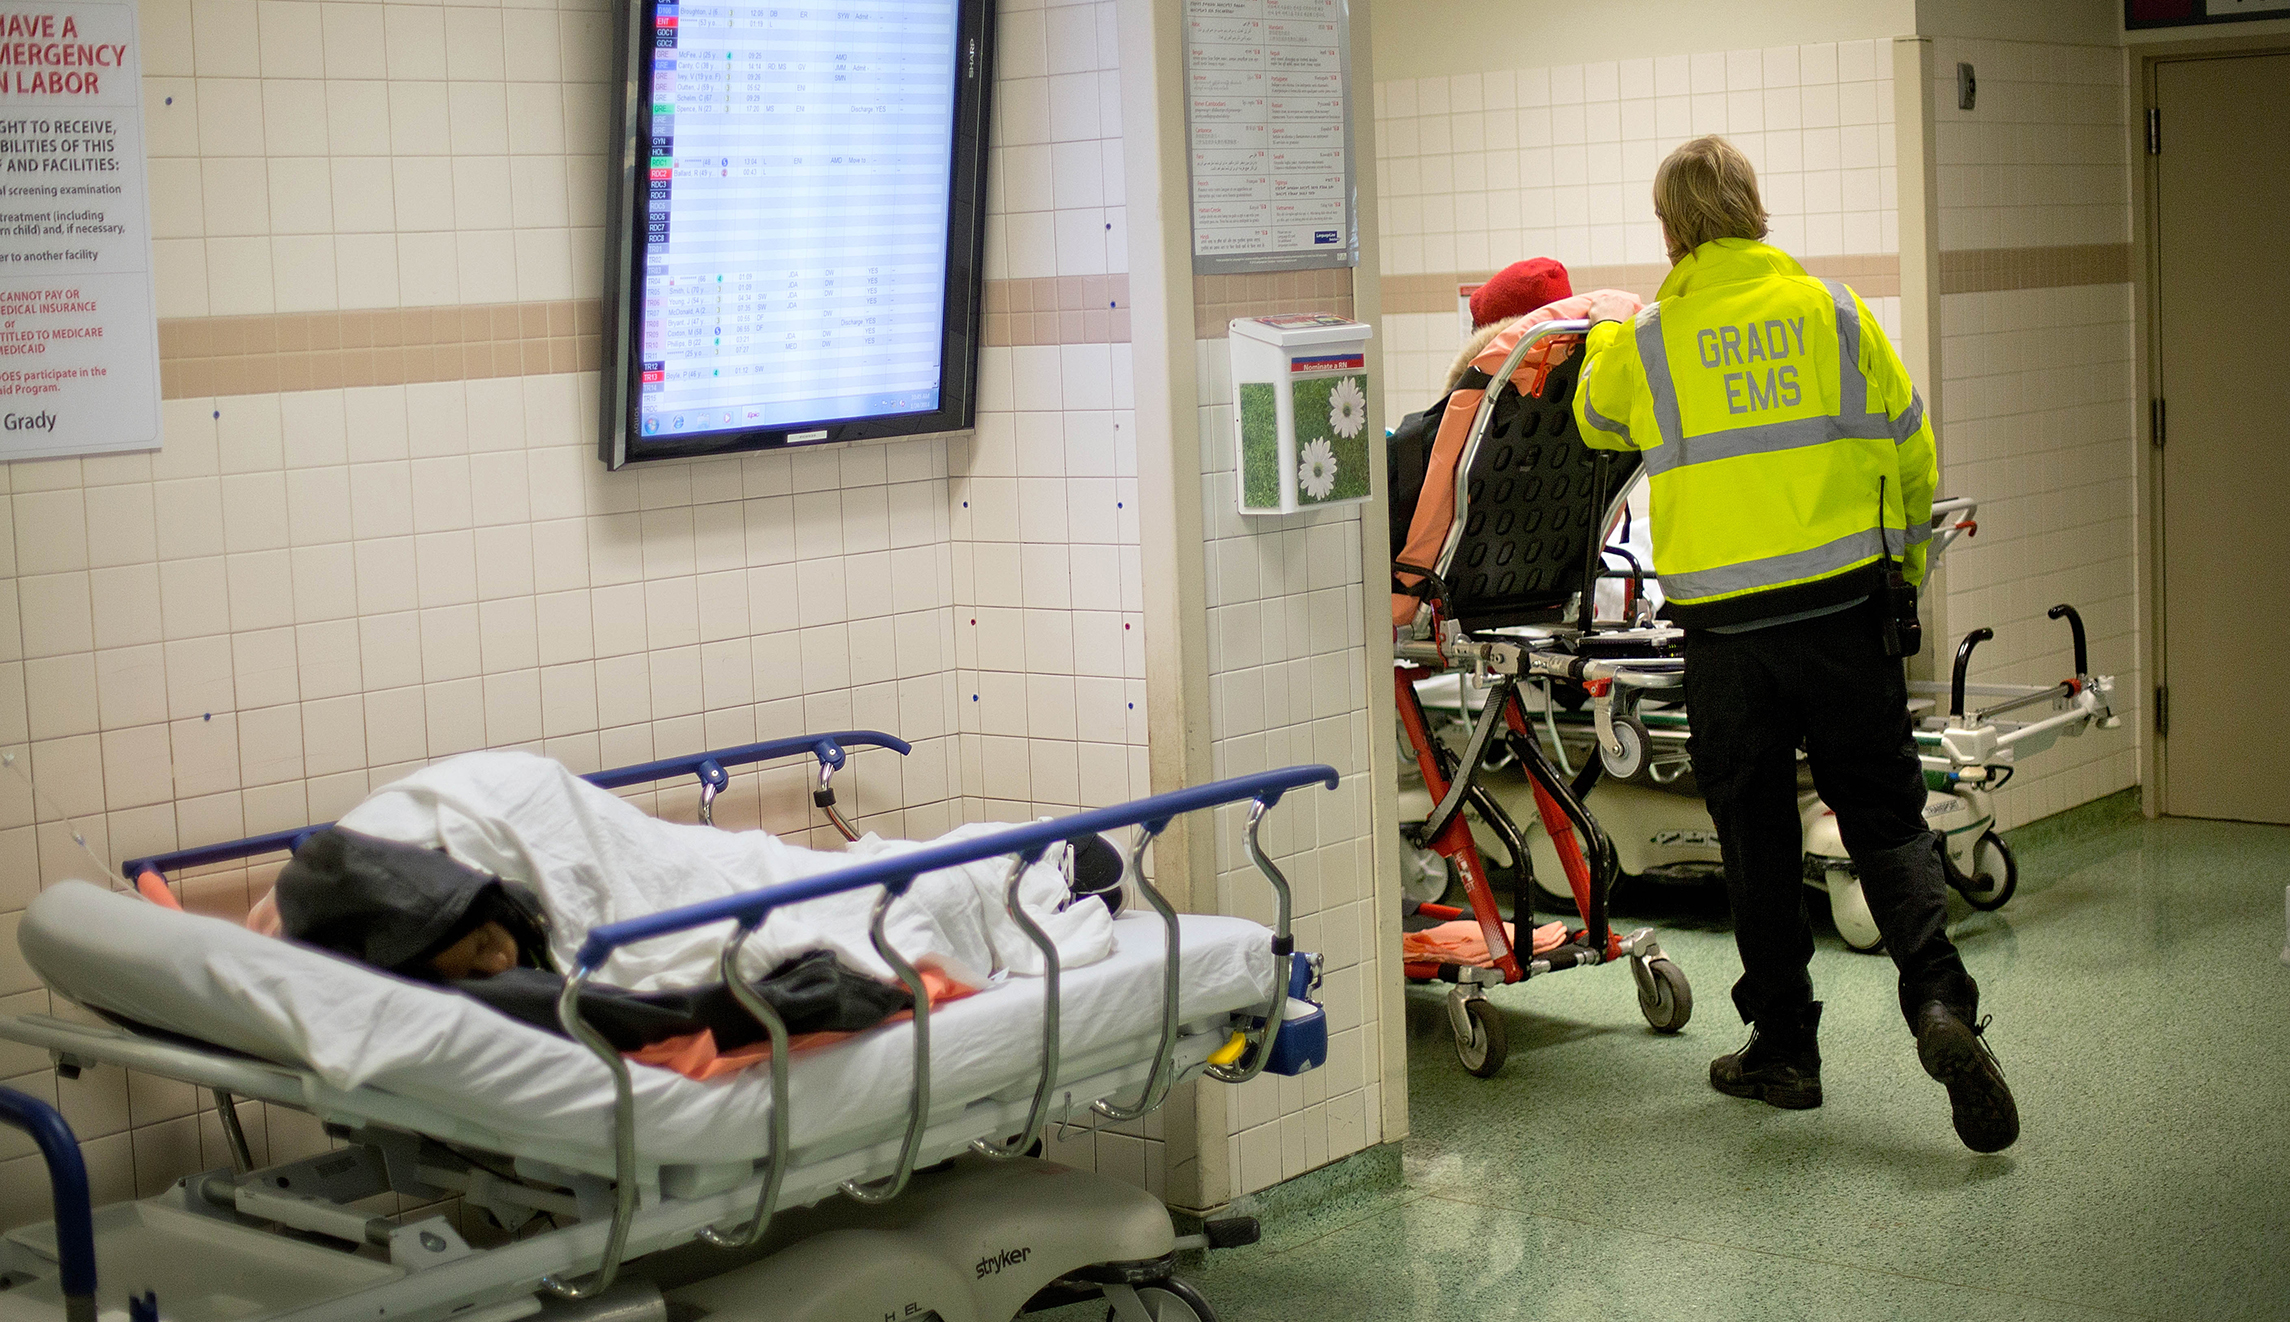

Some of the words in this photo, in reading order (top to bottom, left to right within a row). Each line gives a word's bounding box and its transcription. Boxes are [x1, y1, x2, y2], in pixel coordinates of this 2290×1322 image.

[0, 14, 54, 38] AVE
[62, 16, 78, 38] A
[17, 71, 99, 94] LABOR
[31, 121, 49, 133] TO
[54, 121, 117, 135] RECEIVE,
[1, 140, 56, 152] BILITIES
[61, 140, 79, 152] OF
[83, 139, 114, 152] THIS
[7, 159, 38, 172] AND
[43, 159, 119, 171] FACILITIES:
[9, 185, 57, 197] screening
[60, 184, 121, 195] examination
[0, 213, 50, 222] treatment
[54, 210, 104, 222] (including
[13, 225, 40, 235] child)
[43, 224, 64, 235] and,
[67, 224, 74, 233] if
[76, 224, 125, 234] necessary,
[11, 253, 21, 261] to
[24, 251, 63, 261] another
[66, 250, 98, 261] facility
[0, 291, 42, 302] CANNOT
[45, 290, 62, 300] PAY
[65, 289, 79, 299] OR
[1, 305, 37, 315] EDICAL
[40, 302, 96, 313] INSURANCE
[5, 320, 15, 328] or
[0, 331, 34, 342] TITLED
[36, 330, 49, 340] TO
[52, 328, 103, 339] MEDICARE
[1697, 317, 1805, 369] GRADY
[0, 371, 21, 382] OES
[24, 369, 77, 382] participate
[80, 368, 88, 377] in
[91, 367, 106, 376] the
[15, 384, 60, 395] Program.
[1724, 365, 1801, 415] EMS
[4, 411, 57, 432] Grady
[976, 1247, 1031, 1280] stryker
